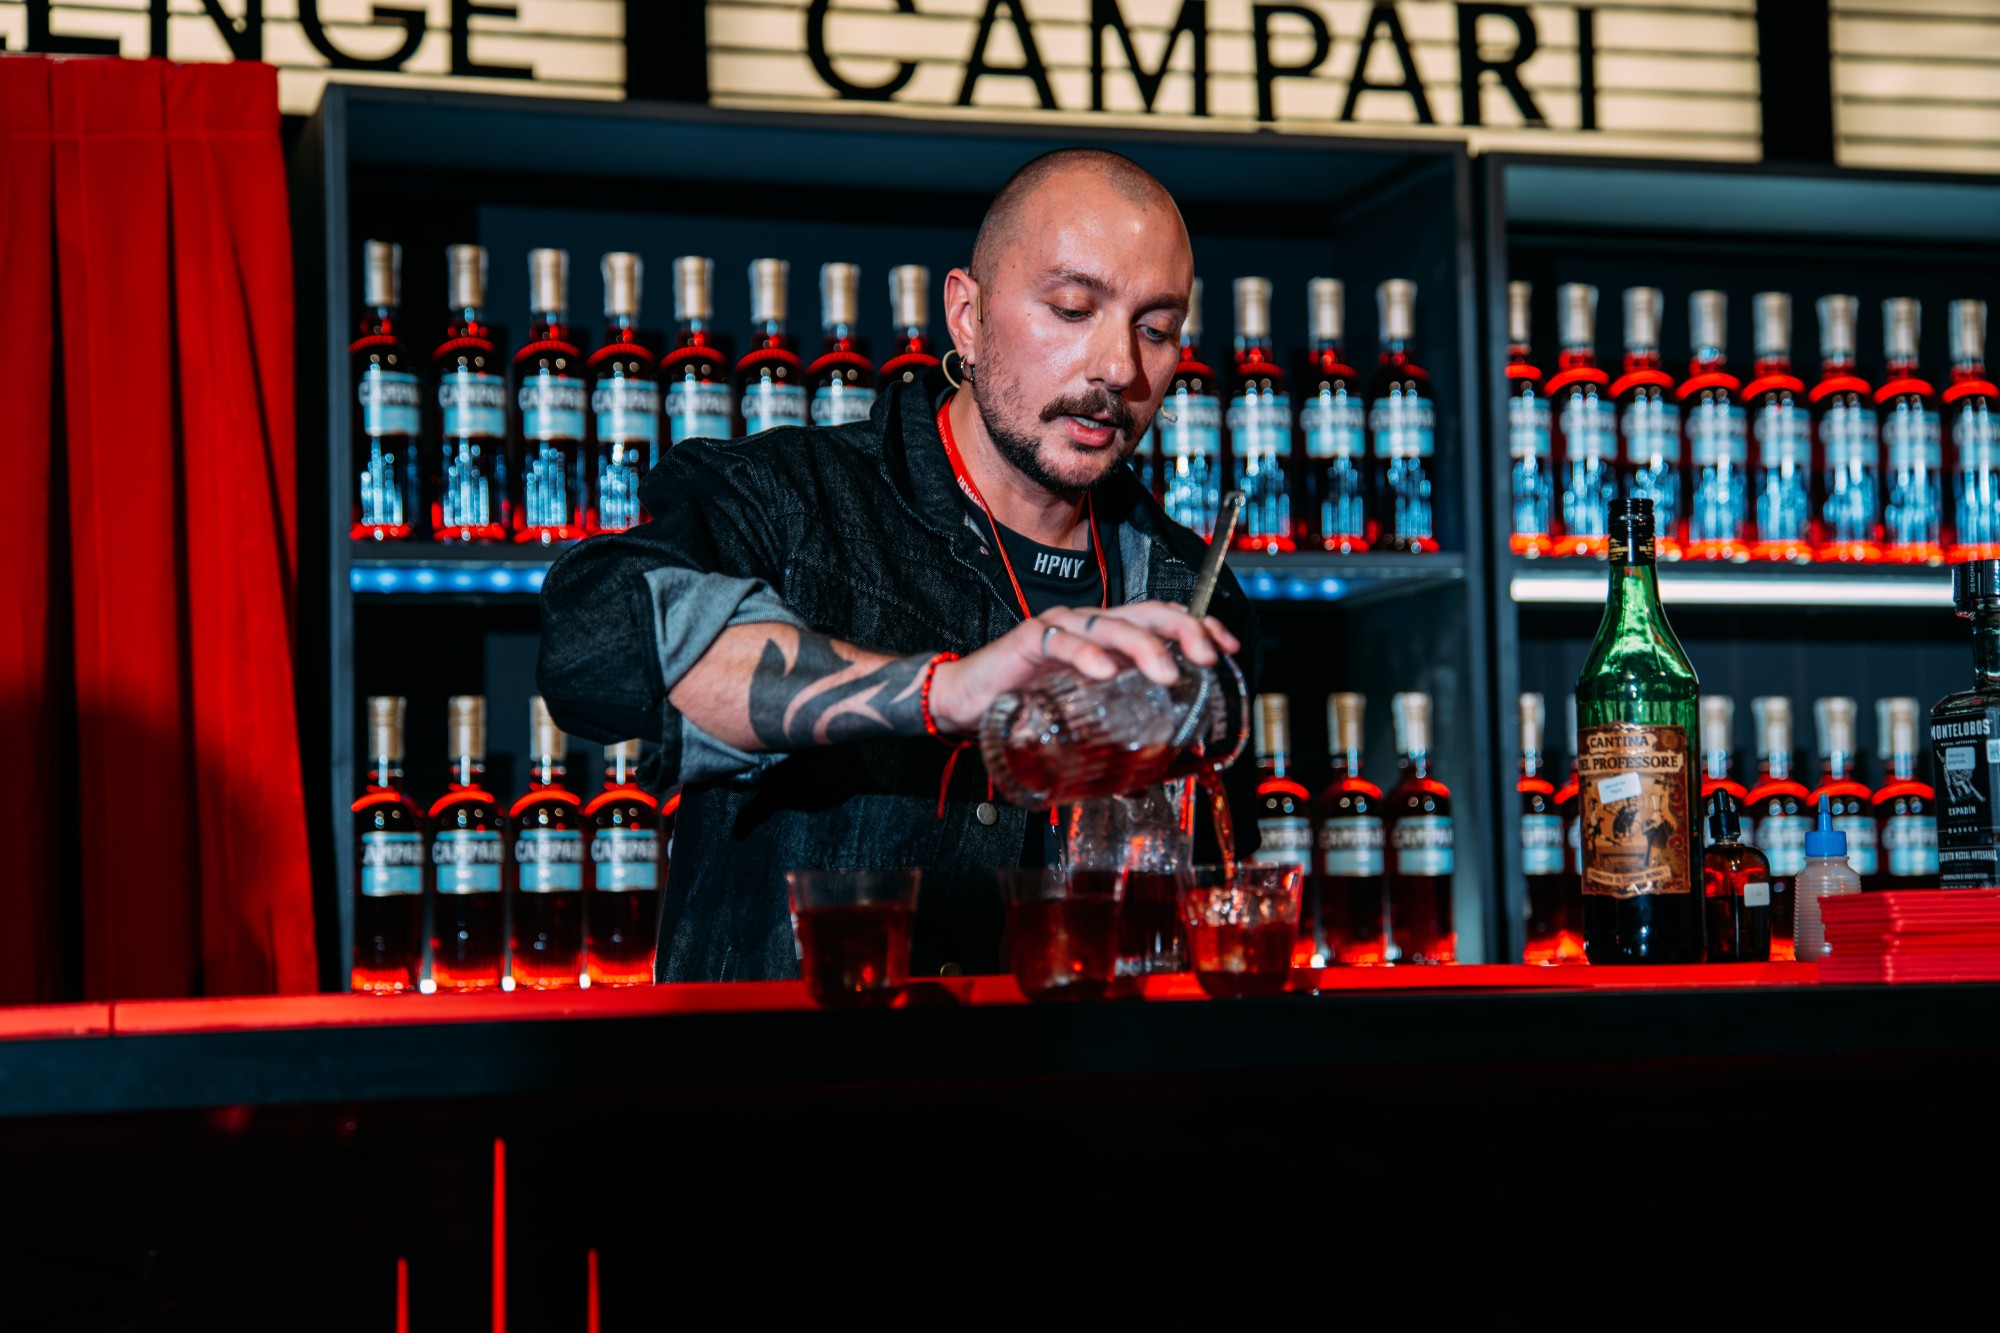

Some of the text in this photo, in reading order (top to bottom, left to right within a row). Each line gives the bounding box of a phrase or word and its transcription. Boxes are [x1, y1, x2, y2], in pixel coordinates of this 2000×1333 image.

[806, 0, 1598, 130] CAMPARI
[1033, 552, 1085, 579] HPNY
[1931, 719, 1991, 740] MONTELOBOS
[1590, 735, 1649, 748] CANTINA
[1593, 756, 1679, 770] PROFESSORE
[1948, 805, 1976, 816] ESPADÍN
[1948, 826, 1978, 834] OAXACA
